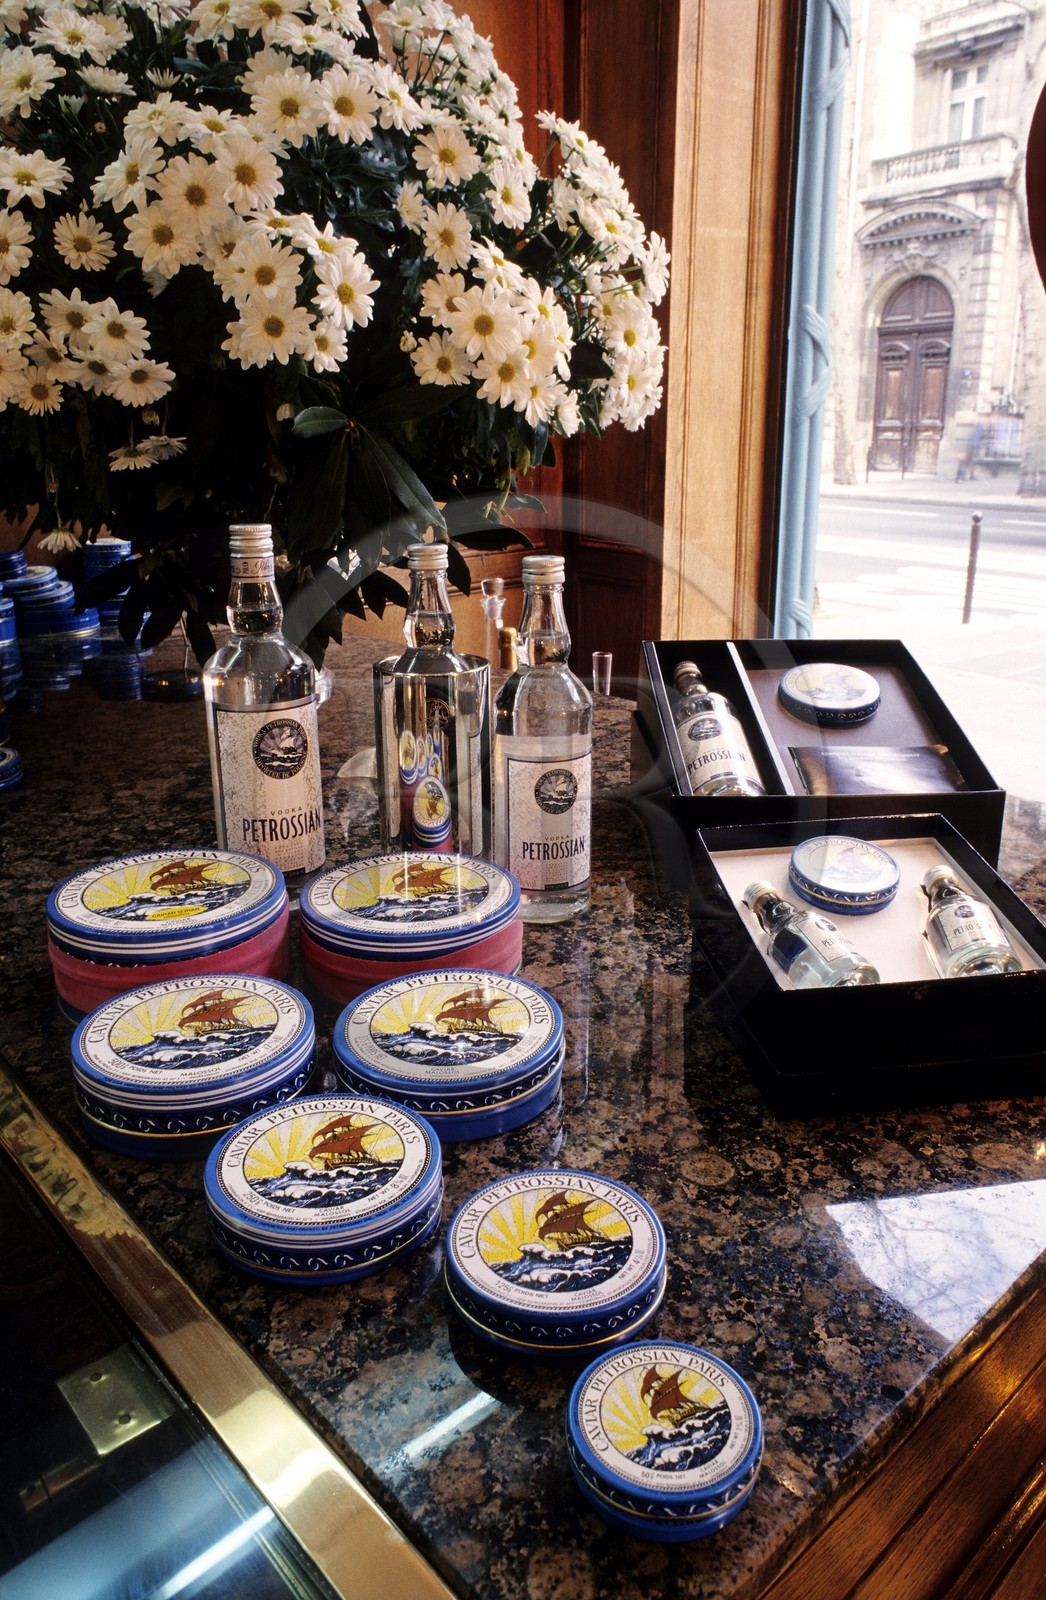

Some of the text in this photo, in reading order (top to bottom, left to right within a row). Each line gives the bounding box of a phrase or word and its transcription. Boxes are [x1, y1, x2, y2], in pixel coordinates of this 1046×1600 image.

[687, 750, 746, 774] PETROSSIN
[271, 807, 303, 816] VODKA
[242, 807, 321, 842] PETROSSIAN
[522, 835, 585, 861] PETROSSIAN
[61, 876, 92, 909] CAVIAR
[99, 850, 219, 875] PETROSSIAN
[227, 854, 266, 874] PARIS
[314, 852, 501, 906] CAVIAR PETROSSIAN PARIS
[352, 974, 549, 1025] CAVIAR PETROSSIAN PARIS
[88, 1002, 133, 1043] CAVIAR
[134, 977, 259, 1001] PETROSSIAN
[263, 988, 297, 1015] PARIS
[252, 1048, 261, 1056] WT
[129, 1065, 146, 1073] POIDS
[179, 1067, 222, 1077] MALOSSOL
[226, 1127, 265, 1168] CAVIAR
[268, 1099, 380, 1124] PETROSSIAN
[383, 1111, 421, 1144] PARIS
[366, 1193, 380, 1202] NET
[378, 1187, 390, 1195] WT
[261, 1200, 281, 1210] POIDS
[313, 1208, 351, 1216] MALOSSOL
[459, 1176, 644, 1259] CAVIAR PETROSSIAN PARIS
[513, 1288, 534, 1297] POIDS
[570, 1289, 603, 1301] MALOSSOL
[573, 1288, 596, 1297] CAVIAR
[582, 1351, 729, 1452] CAVIAR PETROSSIAN PARIS
